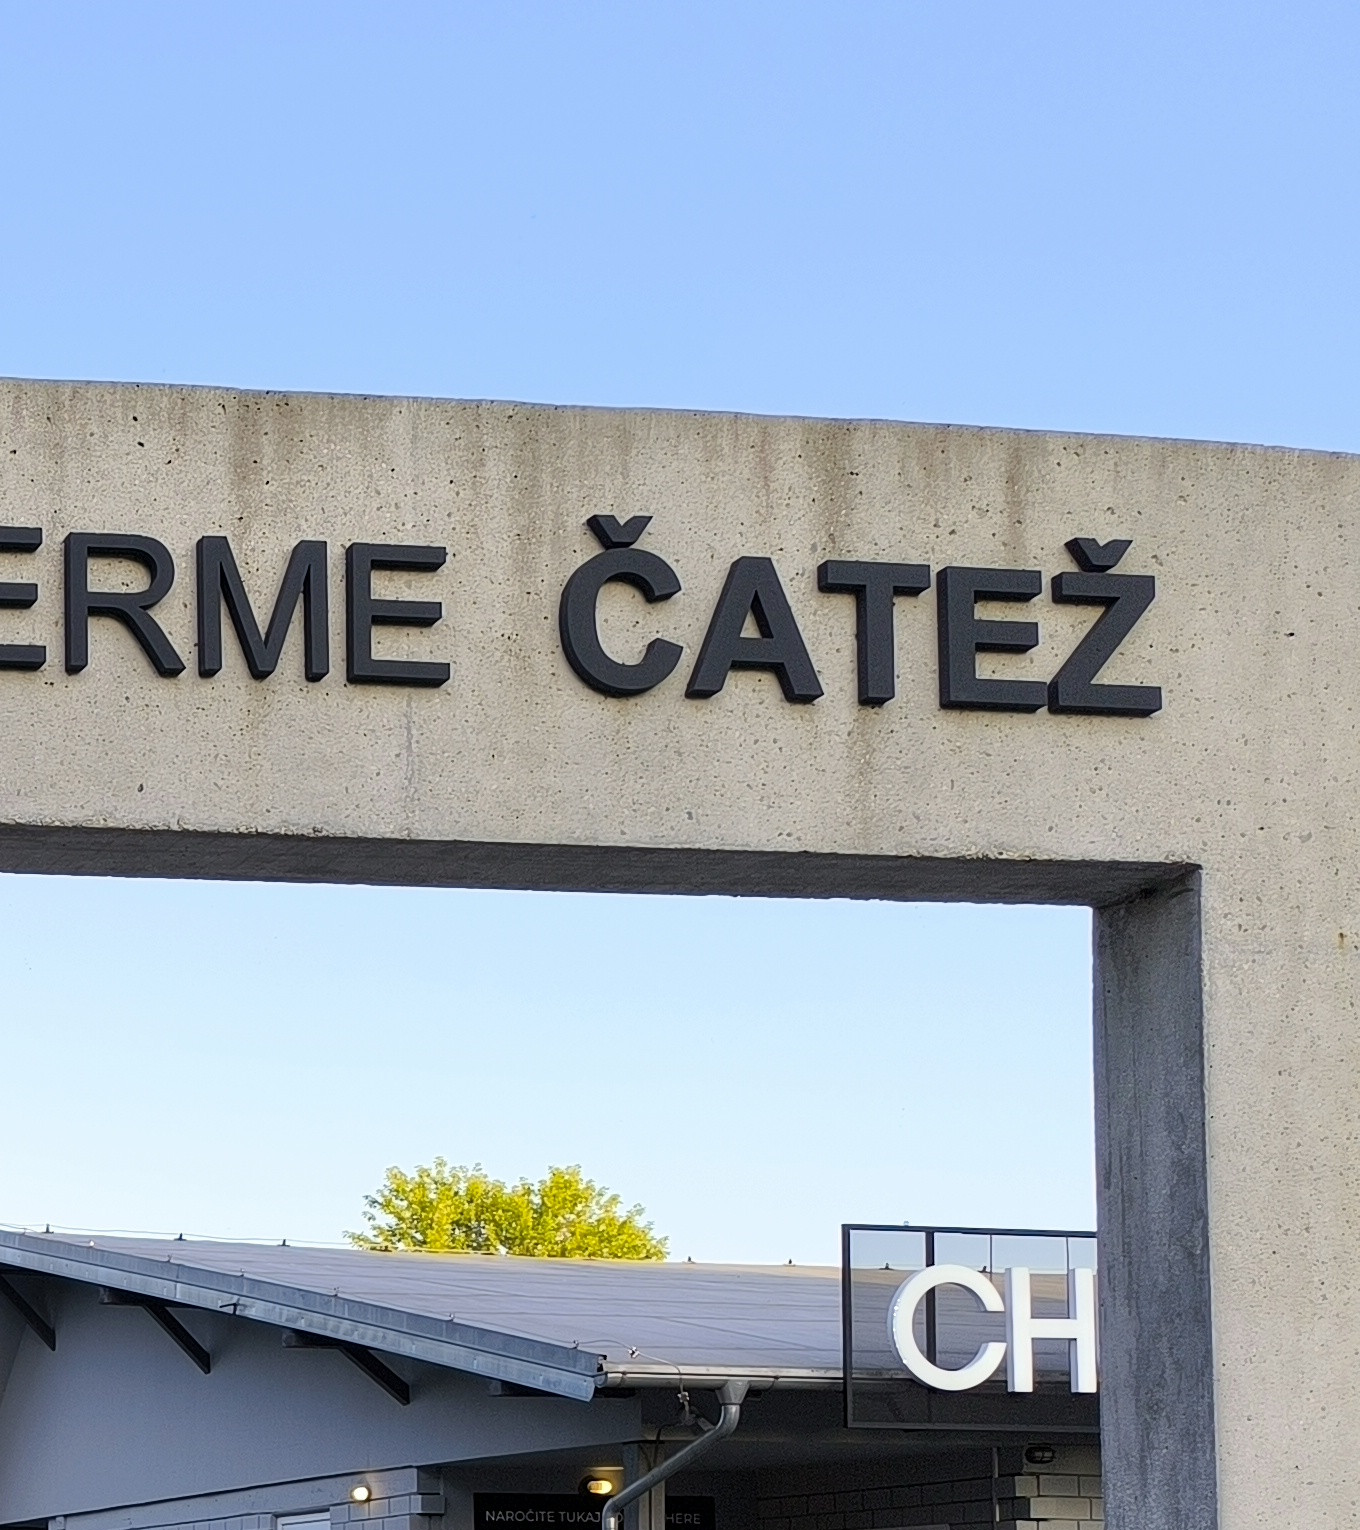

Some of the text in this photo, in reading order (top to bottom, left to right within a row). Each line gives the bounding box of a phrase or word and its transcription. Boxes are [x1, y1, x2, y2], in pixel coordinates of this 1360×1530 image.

[557, 514, 1163, 717] ČATEŽ
[485, 1508, 601, 1523] NAROČITE TUKAJ
